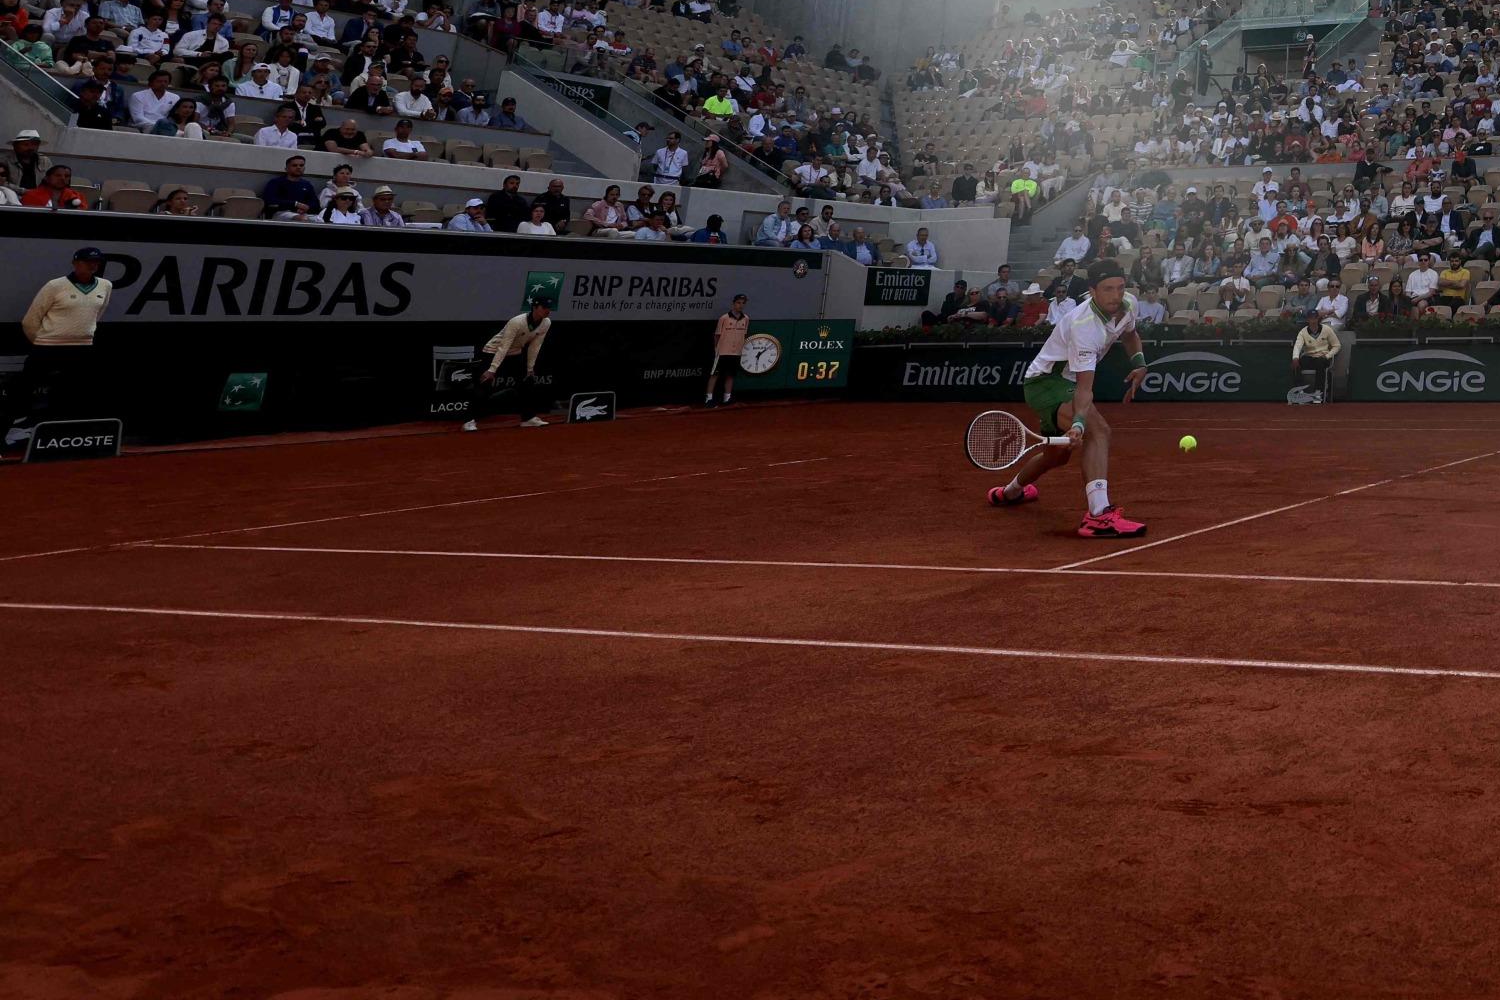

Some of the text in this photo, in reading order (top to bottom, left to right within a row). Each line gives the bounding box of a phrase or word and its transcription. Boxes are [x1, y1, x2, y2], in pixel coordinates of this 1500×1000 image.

[101, 252, 415, 317] PARIBAS
[876, 270, 925, 287] Emirates
[573, 275, 717, 298] BNP PARIBAS
[881, 288, 918, 301] FLY BETTER
[572, 300, 713, 312] The bank for a changing world
[800, 340, 844, 350] ROLEX
[643, 367, 703, 381] BNP PARIBAS
[797, 361, 840, 380] 0:37
[902, 360, 1028, 387] Emirates FL
[430, 401, 471, 413] LACOS
[36, 435, 115, 450] LACOSTE
